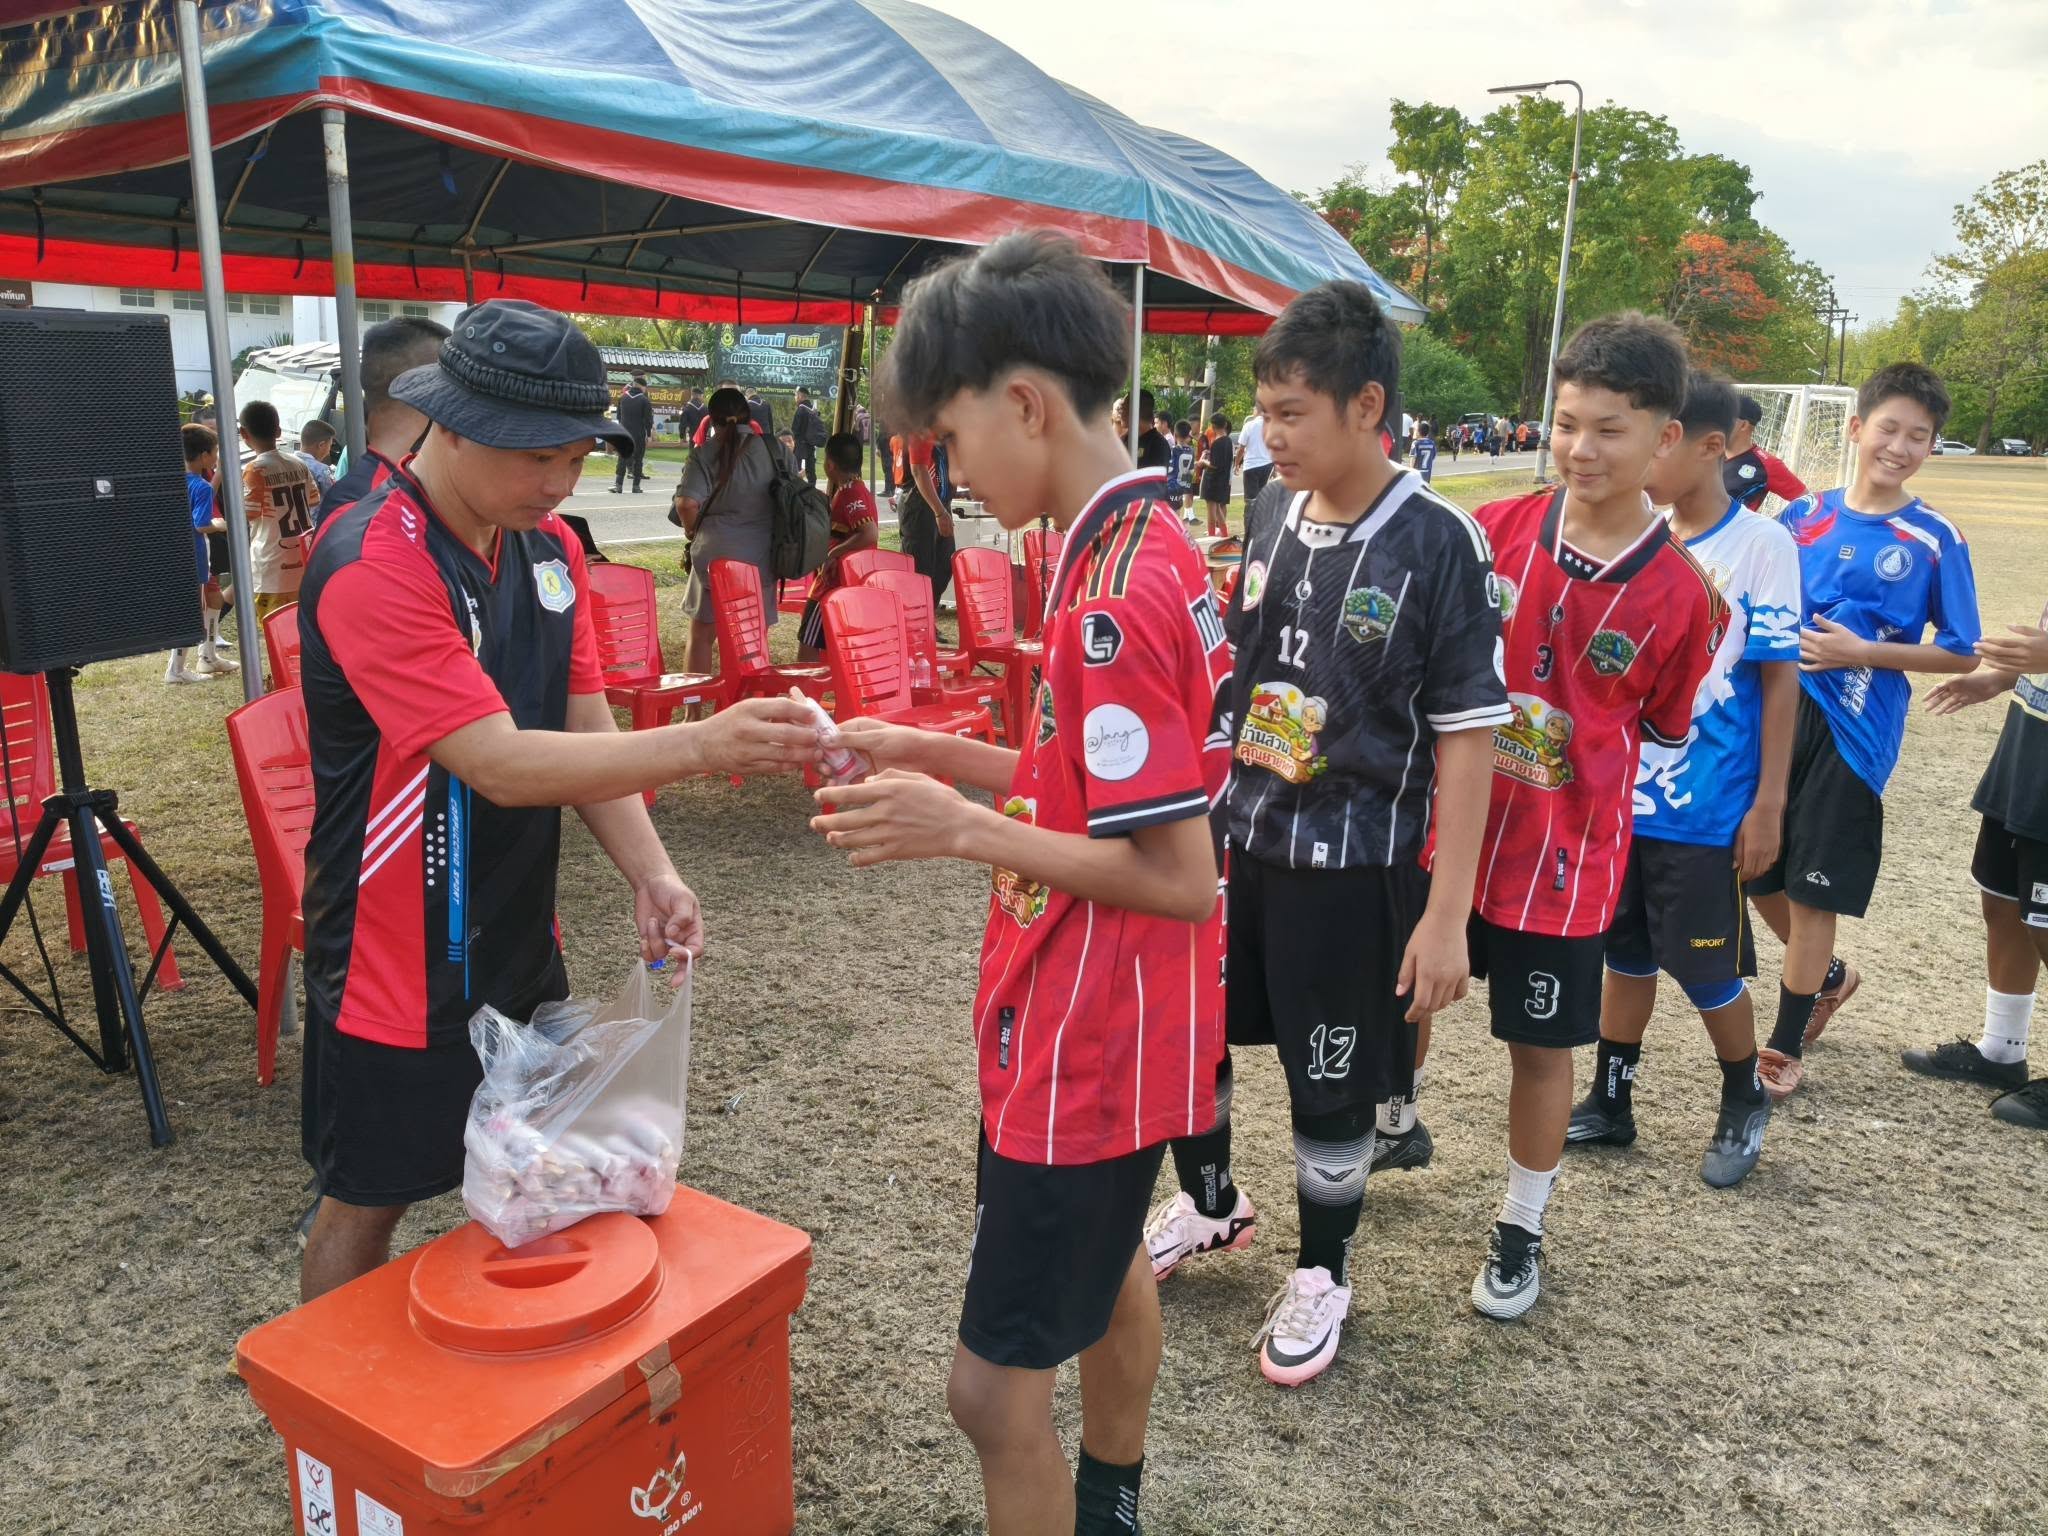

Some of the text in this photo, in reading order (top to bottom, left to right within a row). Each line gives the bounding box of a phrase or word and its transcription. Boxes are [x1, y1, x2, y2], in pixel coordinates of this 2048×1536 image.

[1278, 625, 1309, 671] 12
[1532, 643, 1554, 682] 3
[1525, 970, 1560, 1020] 3
[1308, 1024, 1356, 1079] 12
[681, 1501, 703, 1525] 9001
